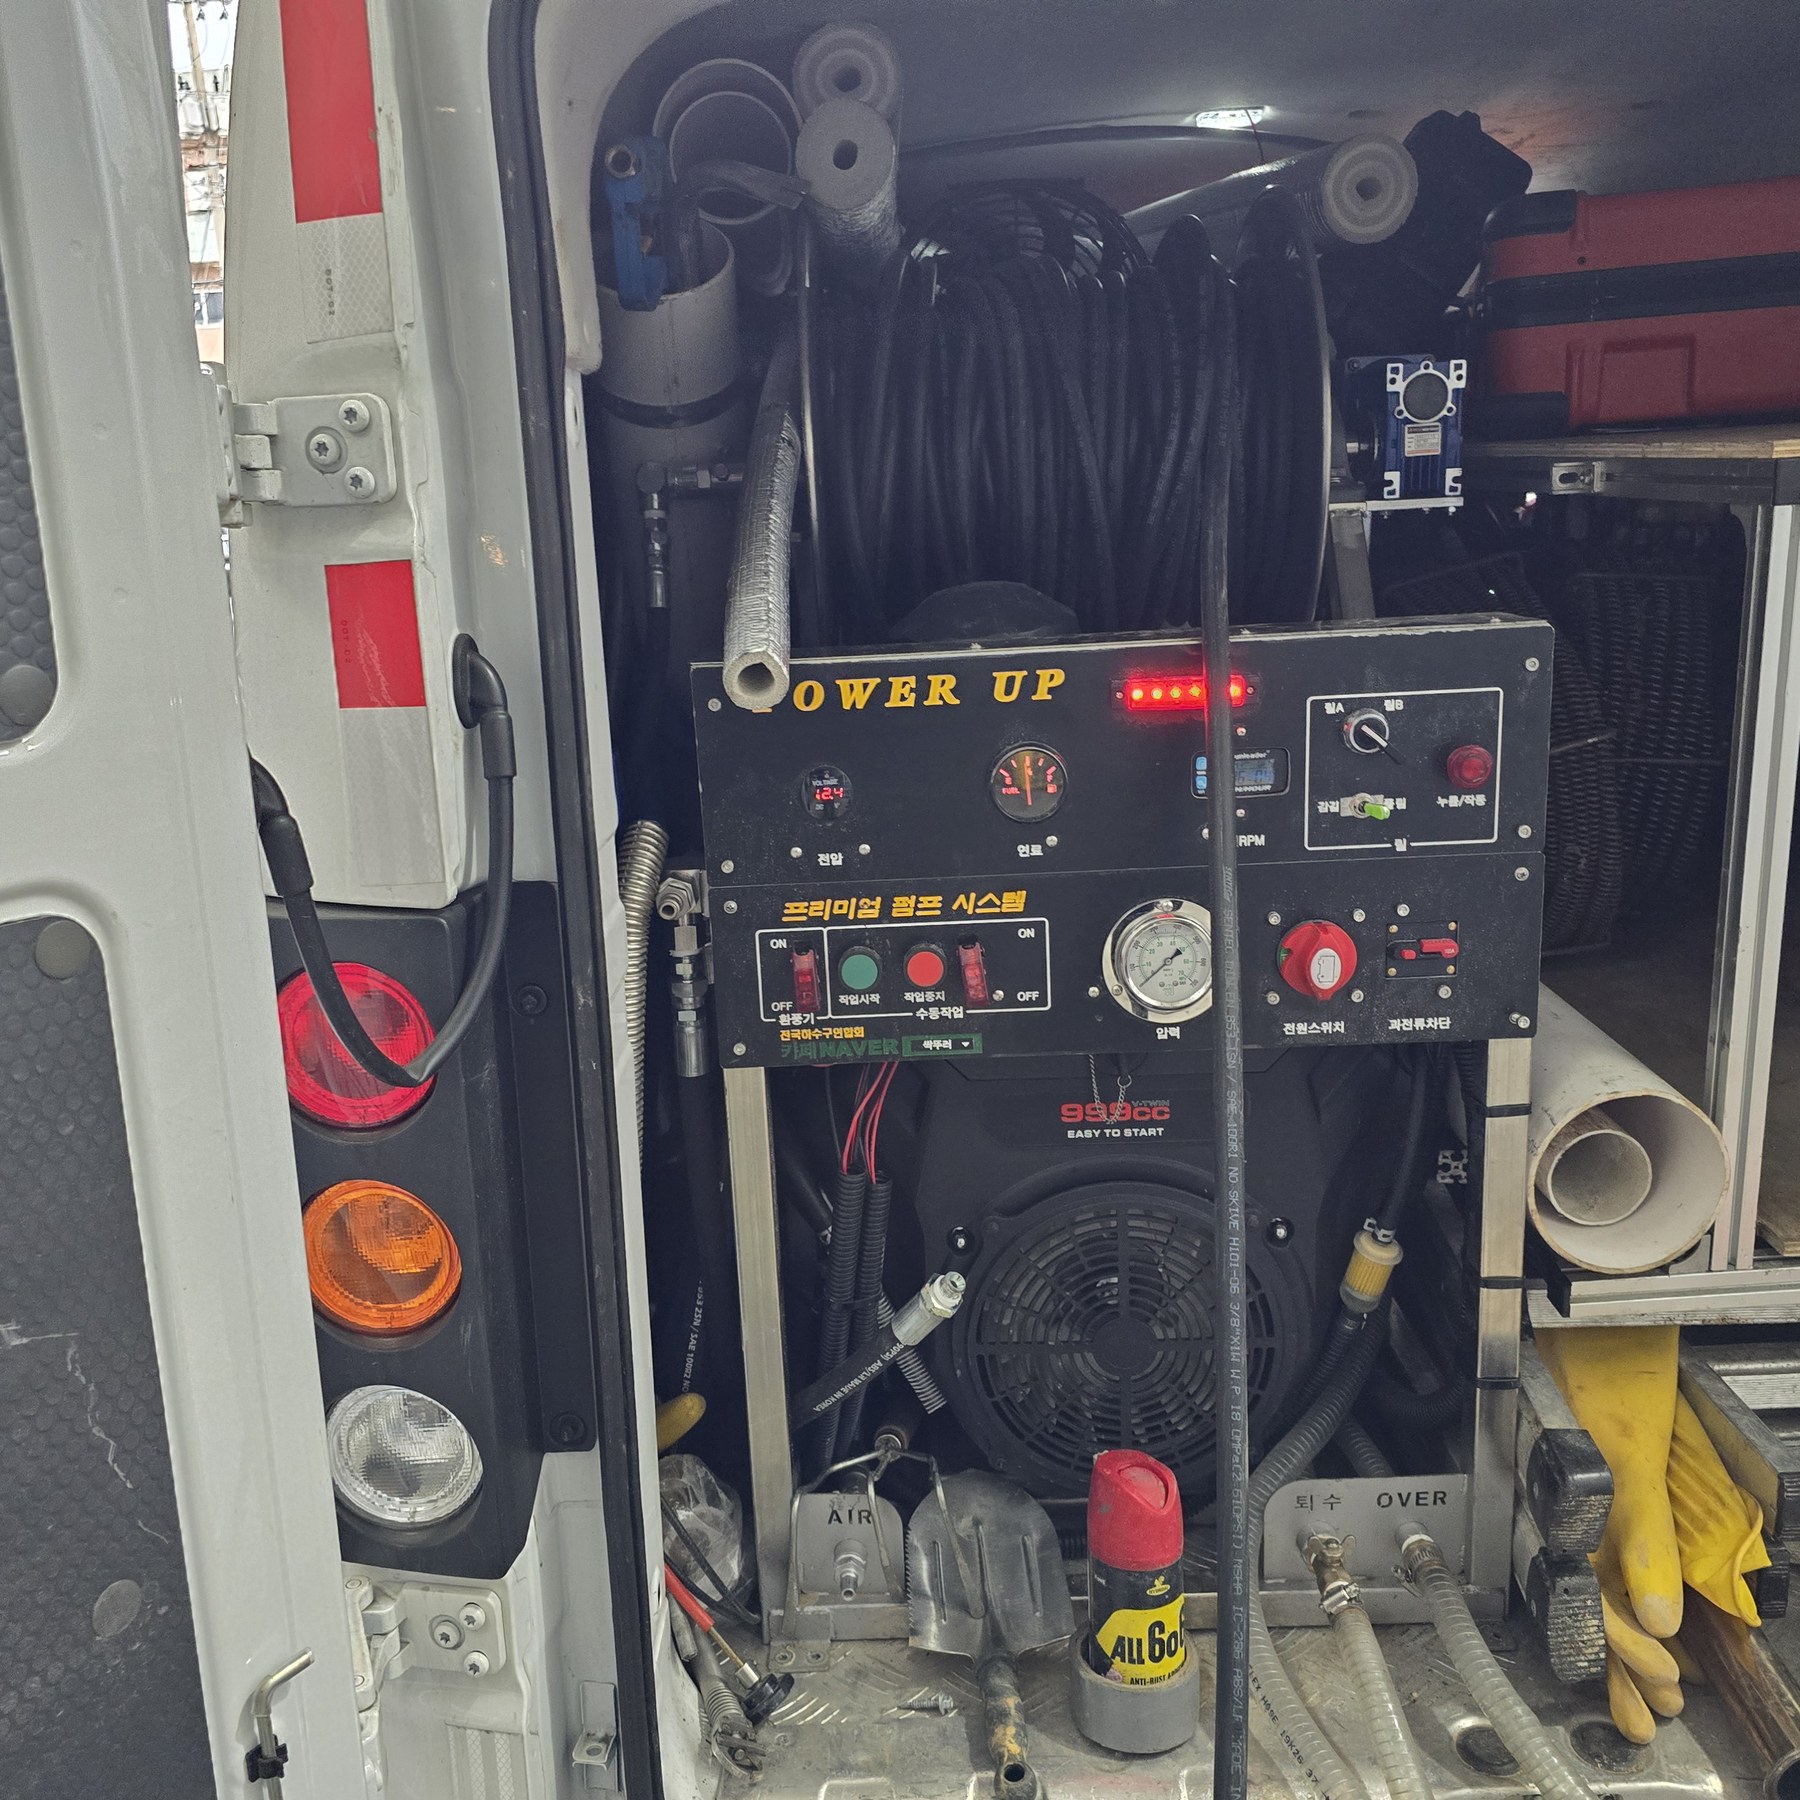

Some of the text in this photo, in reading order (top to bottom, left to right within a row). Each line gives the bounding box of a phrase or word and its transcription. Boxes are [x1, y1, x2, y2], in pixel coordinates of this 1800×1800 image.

[752, 667, 1066, 713] OWER UP
[815, 787, 844, 800] 12.4
[1236, 834, 1266, 847] RPM
[1017, 844, 1044, 857] 연료
[817, 852, 844, 866] 전압
[781, 890, 1027, 922] 프리미엄 펌프 시스템
[1017, 927, 1036, 939] ON
[1224, 909, 1235, 954] SENTEC
[769, 938, 788, 950] ON
[838, 993, 881, 1006] 작업시작
[903, 990, 946, 1003] 작업중지
[1016, 991, 1040, 1002] OFF
[1226, 992, 1237, 1008] EN
[770, 1001, 794, 1012] OFF
[915, 1006, 964, 1020] 수동작업
[778, 1012, 815, 1026] 환풍기
[1226, 1014, 1237, 1038] 853
[1388, 1016, 1451, 1032] 과전류차단
[779, 1026, 865, 1041] 전국하수구연합회
[1156, 1026, 1180, 1040] 압력
[1283, 1020, 1345, 1036] 전원스위치
[1227, 1090, 1237, 1114] SAE
[1060, 1101, 1171, 1123] 999cc
[1067, 1127, 1165, 1138] EASY TO START
[1228, 1122, 1239, 1159] 100R1
[1229, 1167, 1239, 1183] NO
[1229, 1190, 1240, 1231] SKIVE
[1230, 1237, 1241, 1294] H101-06
[688, 1333, 699, 1351] SAE
[880, 1342, 906, 1361] 90PSI)
[813, 1395, 838, 1412] KOREA
[1376, 1491, 1448, 1508] OVER
[828, 1509, 872, 1525] AIR
[1232, 1558, 1243, 1596] MSHA
[1232, 1605, 1244, 1660] IC-286
[1261, 1695, 1279, 1725] HOSE
